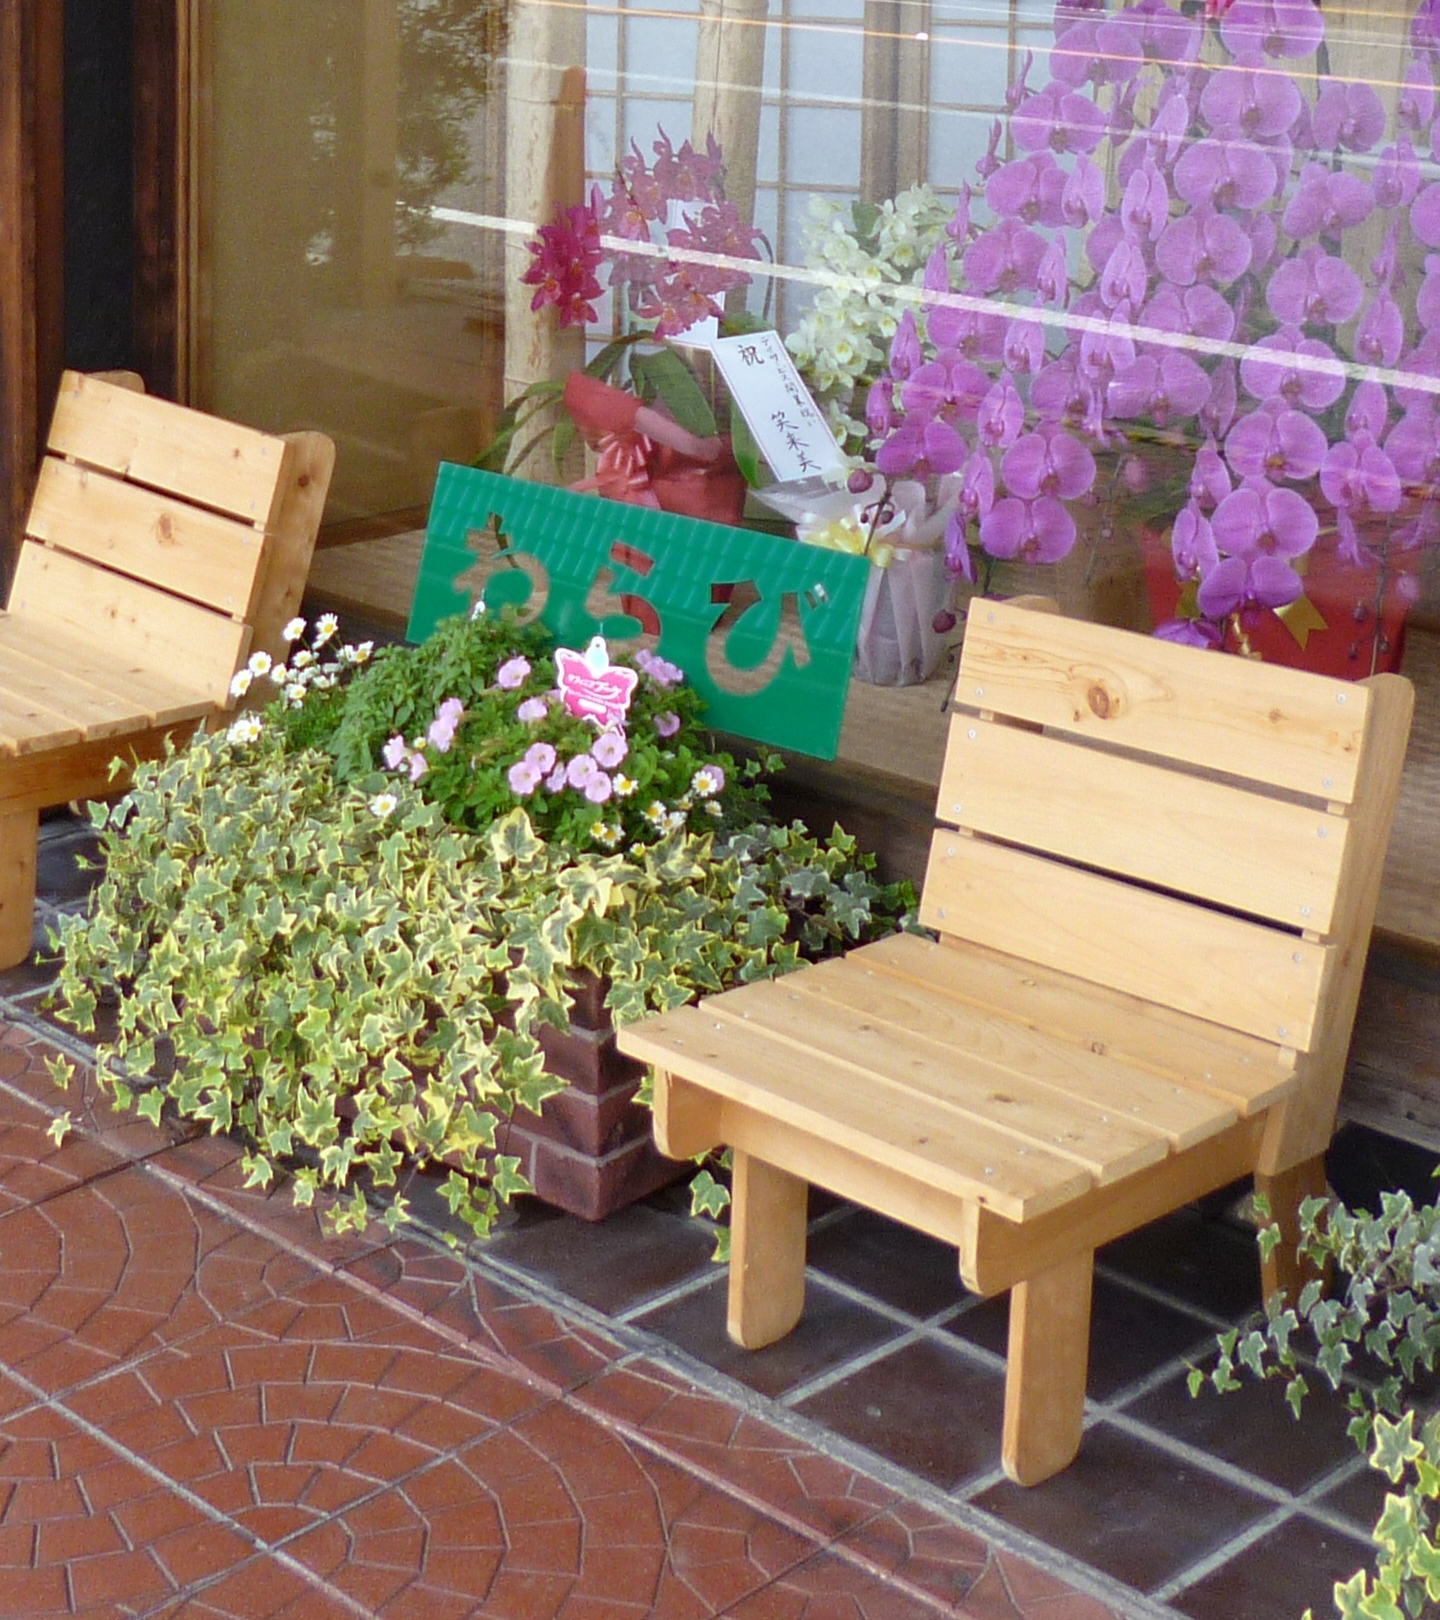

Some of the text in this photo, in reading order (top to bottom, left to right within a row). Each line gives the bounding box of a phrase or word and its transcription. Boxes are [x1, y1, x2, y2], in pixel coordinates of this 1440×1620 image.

[737, 343, 765, 366] 祝
[453, 511, 830, 697] わらび
